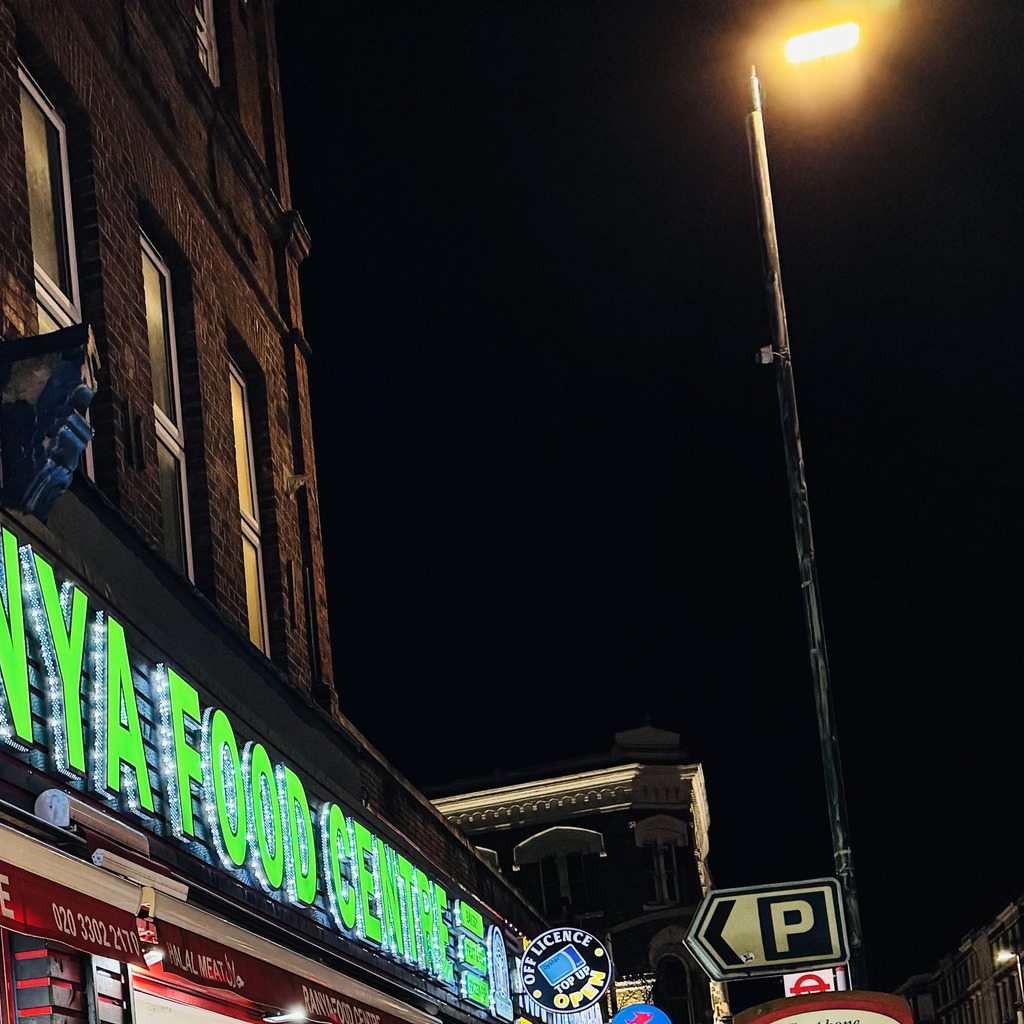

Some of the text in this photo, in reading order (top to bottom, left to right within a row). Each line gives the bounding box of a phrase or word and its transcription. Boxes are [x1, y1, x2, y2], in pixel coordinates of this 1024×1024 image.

[167, 666, 317, 905] FOOD
[328, 803, 454, 986] CENTRE
[52, 902, 140, 956] 020 3302 2170
[770, 900, 814, 953] P
[167, 942, 227, 984] HALAL MEAT
[523, 930, 593, 985] OFF LICENCE
[554, 965, 591, 994] TOP UP
[301, 985, 332, 1018] RANYA
[553, 970, 606, 1009] OPEN
